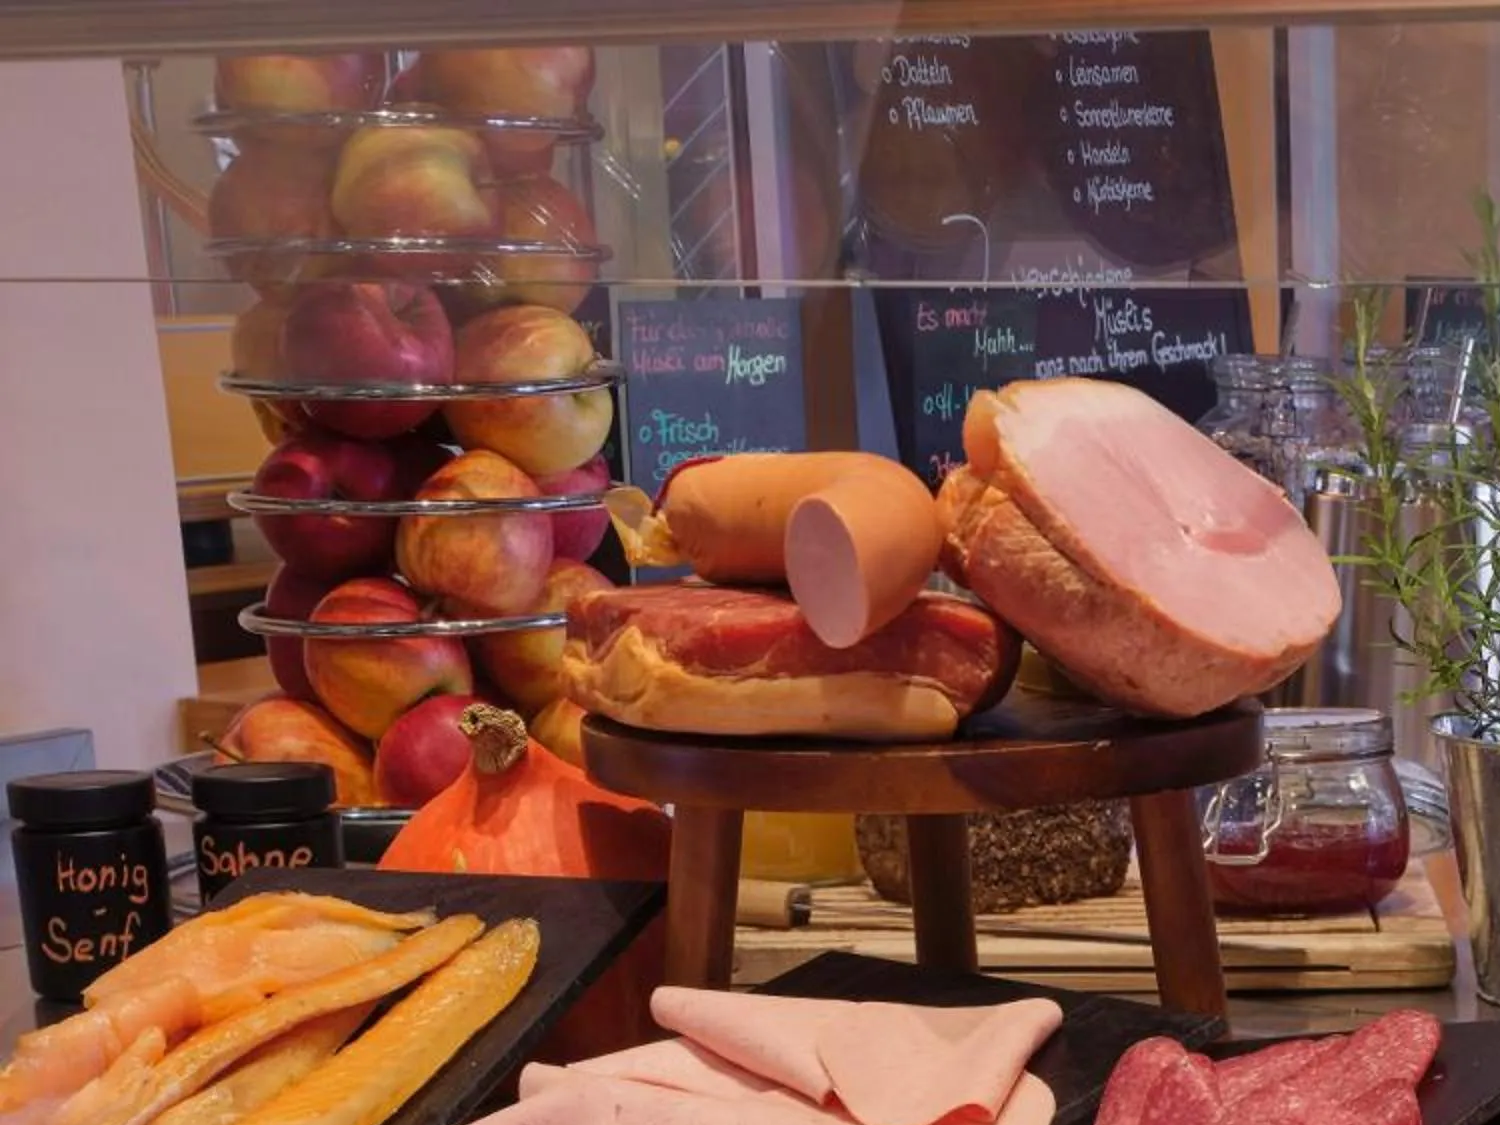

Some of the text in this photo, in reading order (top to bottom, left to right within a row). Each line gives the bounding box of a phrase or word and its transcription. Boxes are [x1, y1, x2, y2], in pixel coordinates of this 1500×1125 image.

[902, 96, 980, 131] Pflaumen
[916, 302, 939, 332] Es
[725, 343, 788, 385] Morgen
[1068, 347, 1107, 374] nach
[1106, 338, 1149, 374] ihrem
[650, 408, 719, 447] Frisch
[199, 834, 314, 878] Sahne
[57, 852, 149, 904] Honig
[41, 914, 142, 964] Senf
